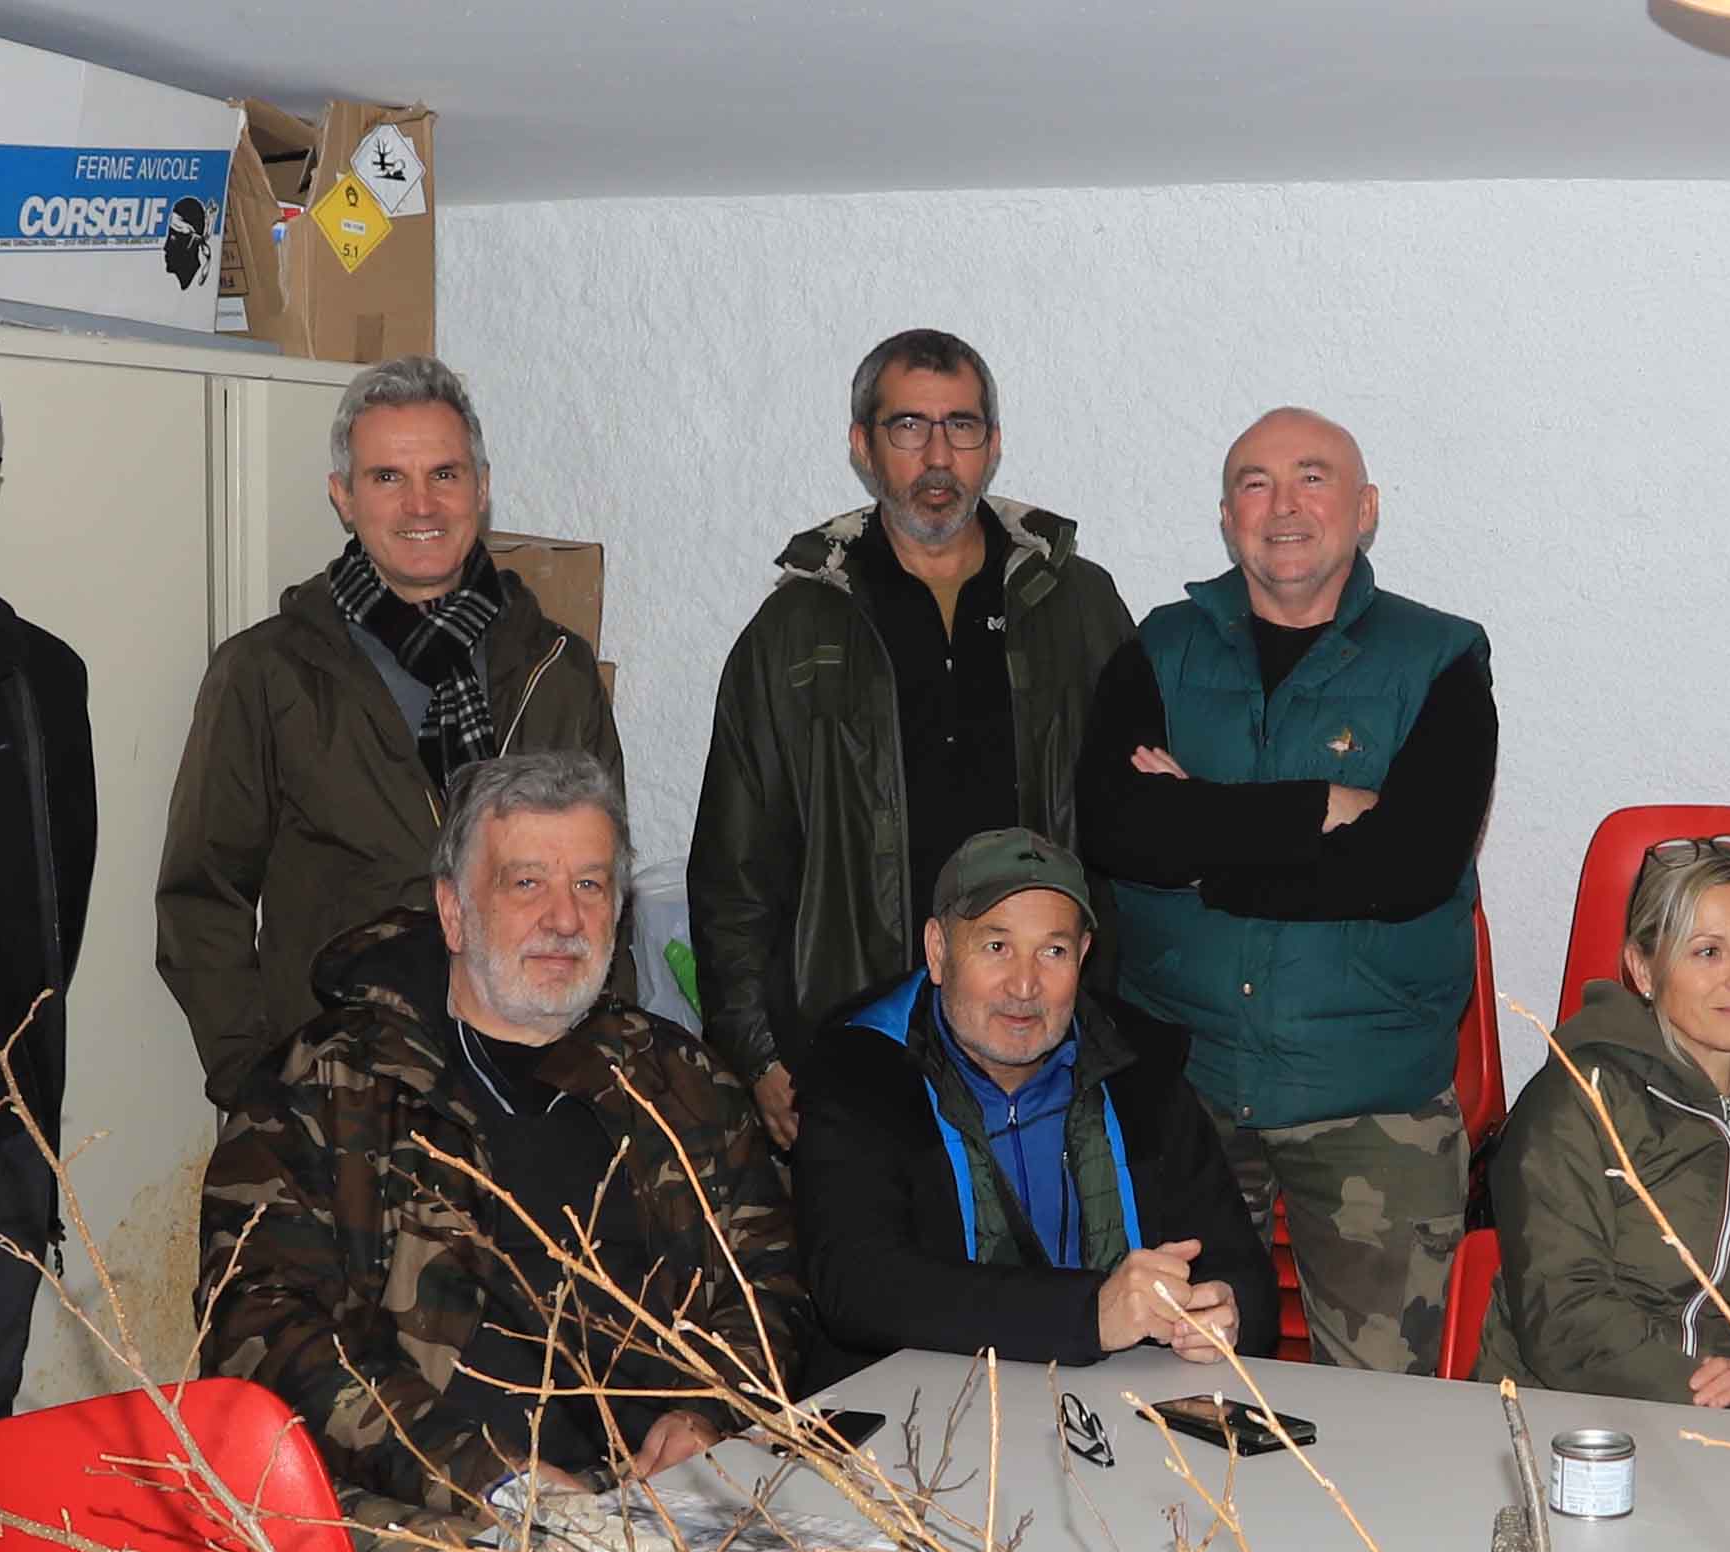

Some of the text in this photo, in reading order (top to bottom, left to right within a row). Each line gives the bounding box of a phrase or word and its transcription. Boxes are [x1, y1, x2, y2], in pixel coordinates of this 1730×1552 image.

[75, 155, 200, 180] FERME AVICOLE
[20, 195, 168, 236] CORSŒUF
